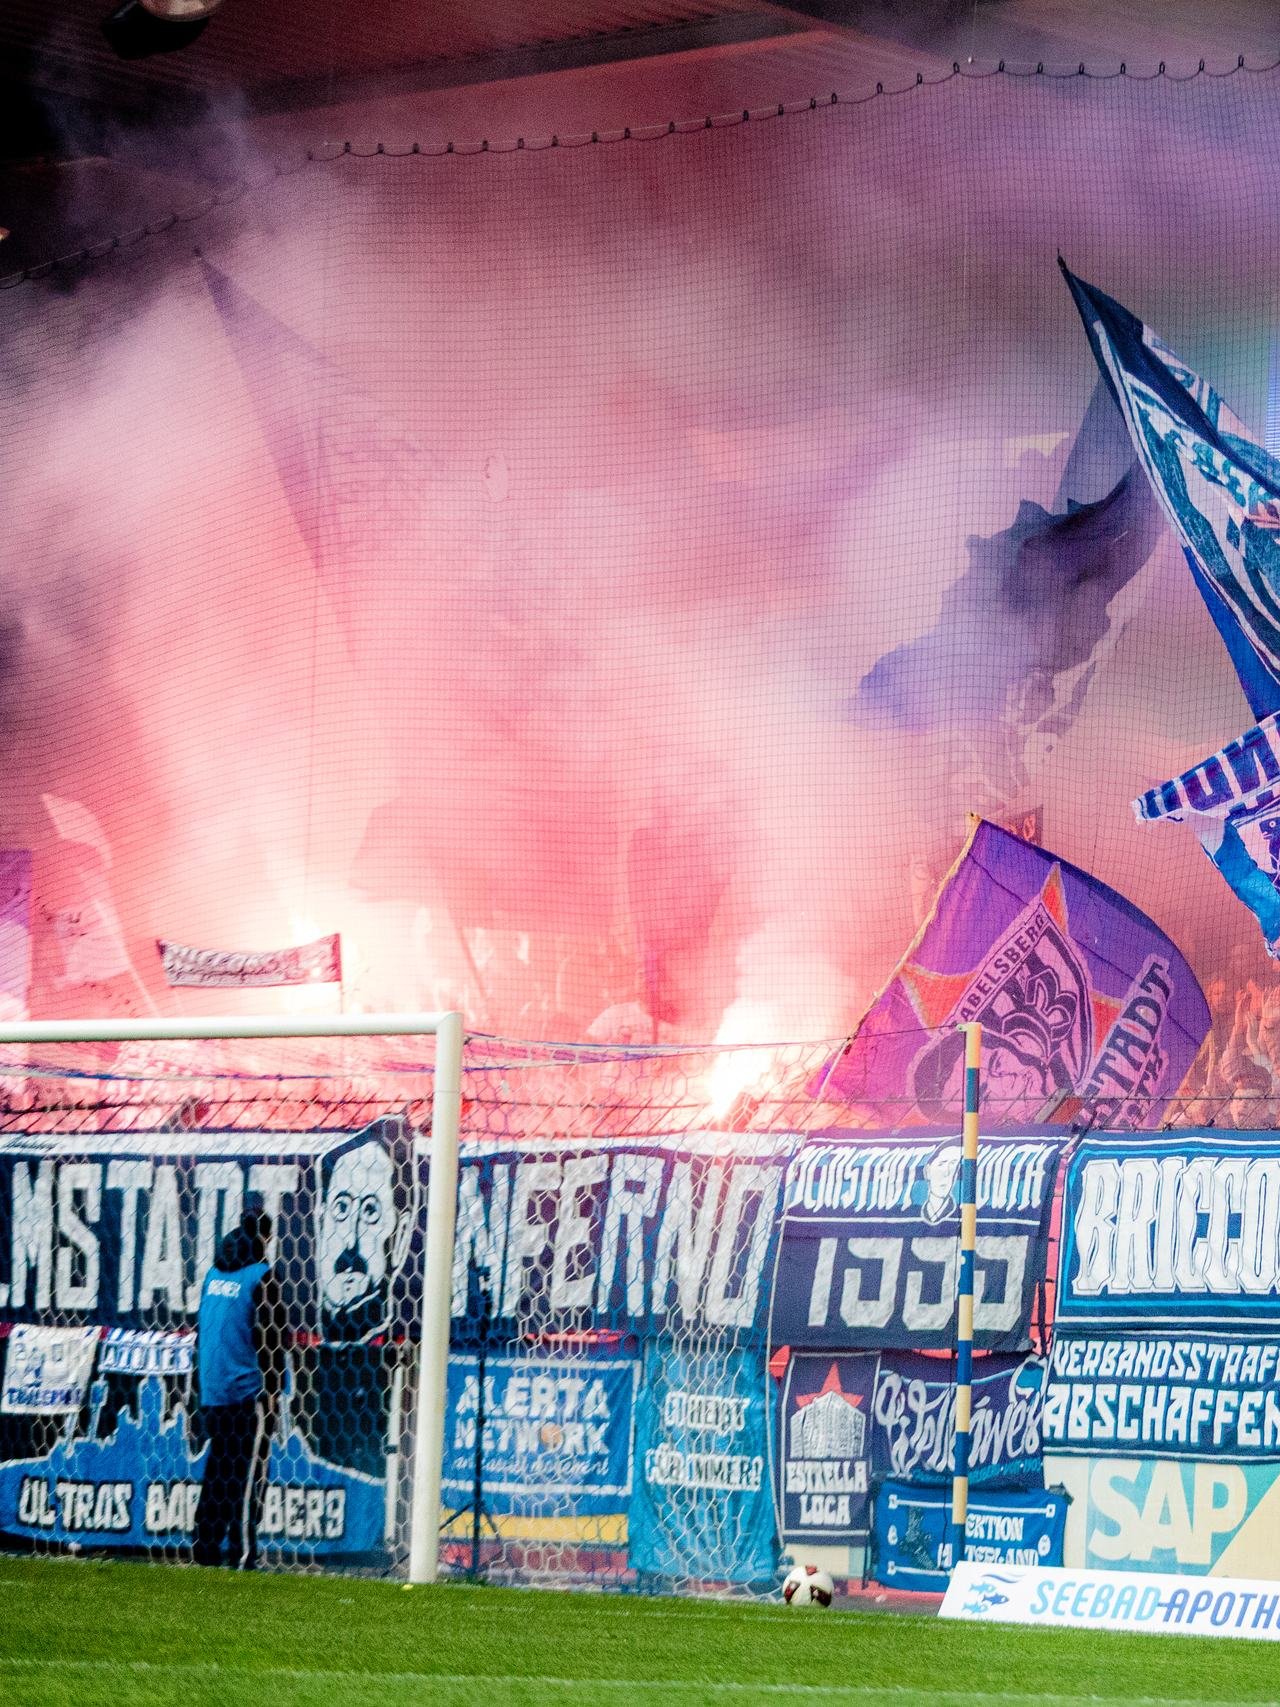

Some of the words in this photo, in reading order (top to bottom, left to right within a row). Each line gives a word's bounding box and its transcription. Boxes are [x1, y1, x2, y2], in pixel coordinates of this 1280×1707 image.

[951, 912, 1049, 1036] ABELSBERG
[0, 1159, 300, 1312] MSTADT
[452, 1153, 783, 1328] NFERNO
[455, 1375, 611, 1420] ALERTA
[786, 1461, 868, 1493] ESTRELLA
[18, 1478, 132, 1530] ULTRAS
[799, 1496, 851, 1525] LOCA
[964, 1513, 1025, 1541] EKTION
[1089, 1461, 1248, 1565] SAP
